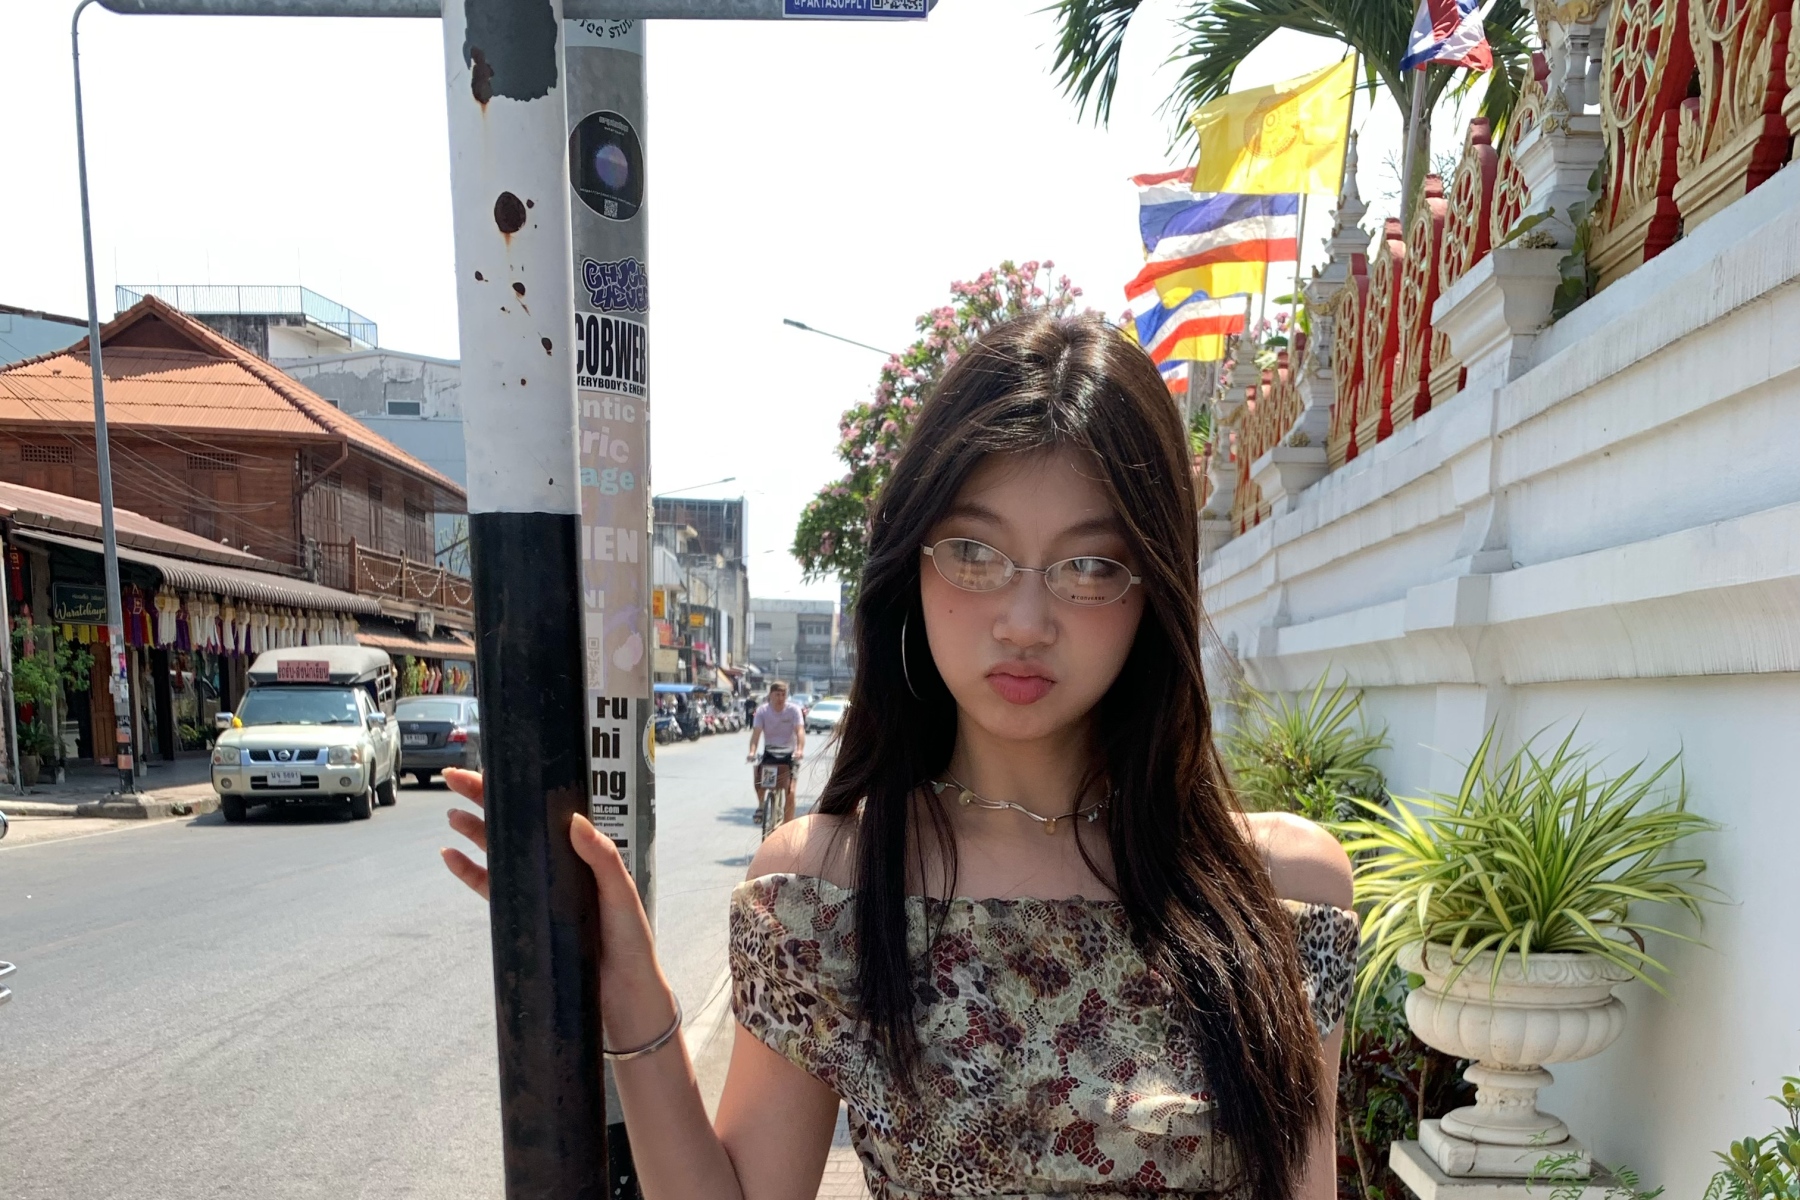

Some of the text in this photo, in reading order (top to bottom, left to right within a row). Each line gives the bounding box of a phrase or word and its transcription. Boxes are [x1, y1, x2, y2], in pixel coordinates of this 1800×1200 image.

[575, 312, 646, 385] COBWEB
[579, 397, 635, 423] ntic
[592, 727, 620, 759] hi
[592, 770, 626, 801] ng
